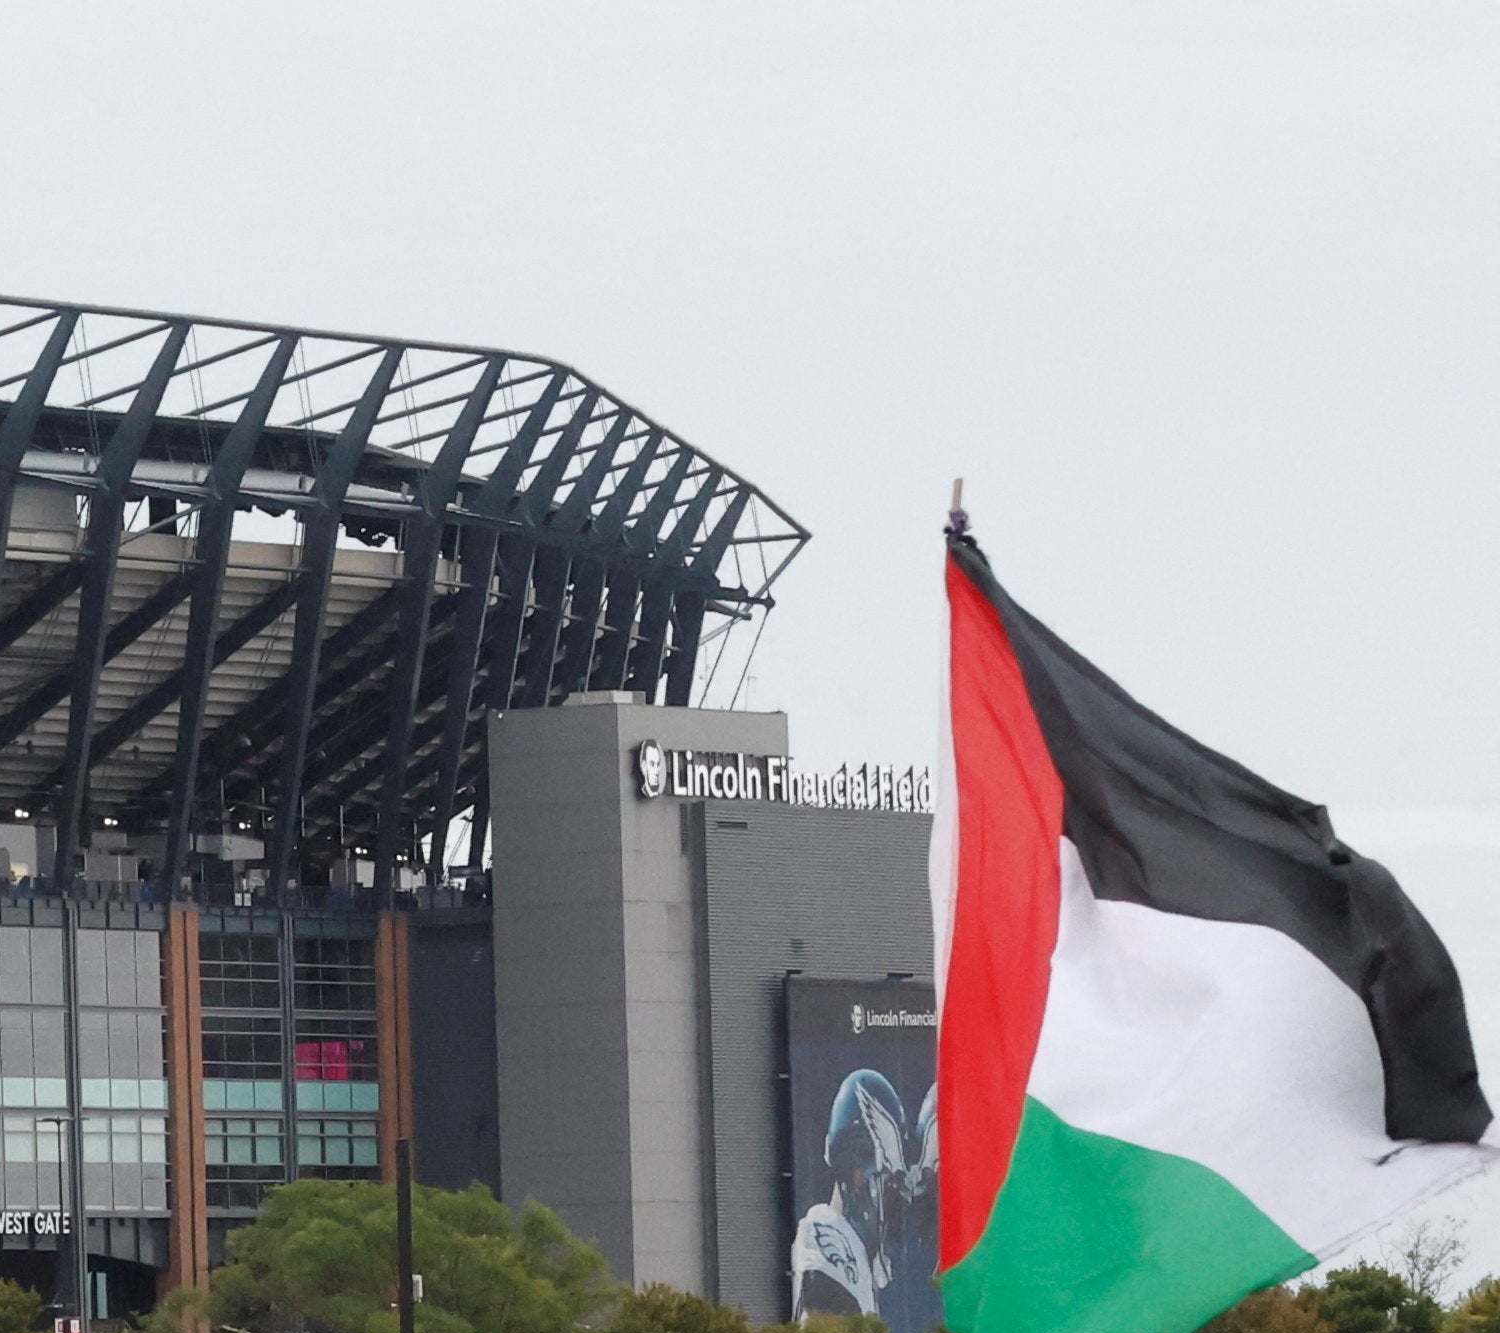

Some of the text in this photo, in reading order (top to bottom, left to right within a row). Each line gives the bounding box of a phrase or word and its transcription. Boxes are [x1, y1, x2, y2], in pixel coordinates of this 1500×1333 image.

[672, 750, 935, 813] Lincoln Financial Field
[866, 1009, 937, 1027] Lincoln Financial
[34, 1211, 71, 1235] GATE
